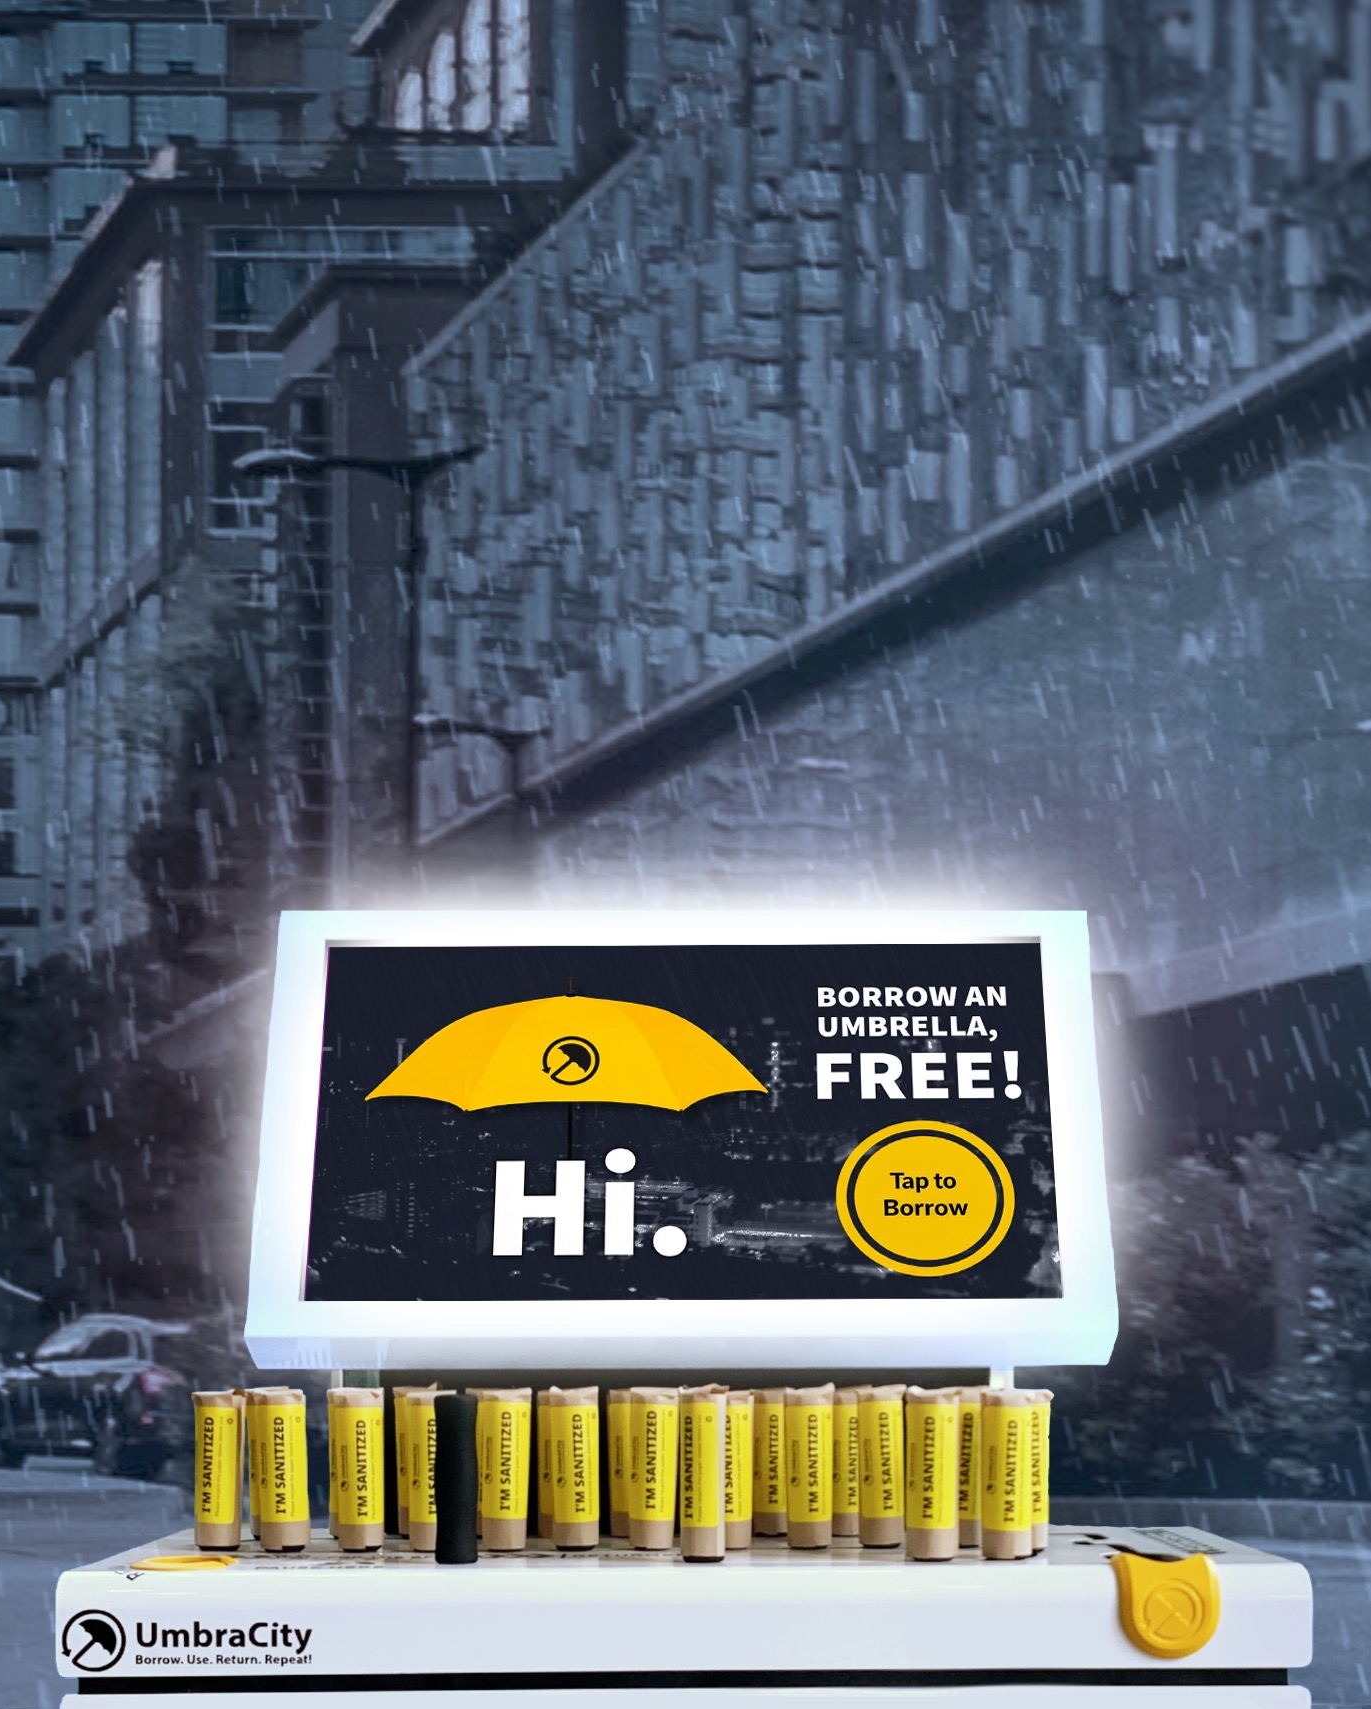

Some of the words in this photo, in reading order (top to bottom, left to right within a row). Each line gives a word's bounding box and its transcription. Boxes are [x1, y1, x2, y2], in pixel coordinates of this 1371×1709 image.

[817, 986, 957, 1007] BORROW
[964, 986, 1007, 1006] AN
[817, 1015, 998, 1042] UMBRELLA,
[816, 1051, 1022, 1100] FREE!
[492, 1148, 688, 1257] Hi.
[883, 1199, 968, 1216] Borrow
[889, 1172, 929, 1193] Tap
[934, 1173, 957, 1189] to
[203, 1417, 214, 1487] SANITIZED
[274, 1416, 286, 1488] SANITIZED
[356, 1420, 368, 1491] SANITIZED
[500, 1411, 512, 1485] SANITIZED
[572, 1413, 585, 1491] SANITIZED
[646, 1410, 657, 1484] SANITIZED
[684, 1416, 693, 1492] SANITIZED
[769, 1414, 779, 1480] SANITIZED
[808, 1414, 819, 1487] SANITIZED
[879, 1412, 892, 1488] SANITIZED
[923, 1416, 936, 1492] SANITIZED
[1005, 1420, 1018, 1495] SANITIZED
[135, 1654, 184, 1665] Borrow.
[186, 1654, 213, 1665] Use.
[216, 1654, 262, 1665] Return.
[264, 1654, 312, 1667] Repeat!
[136, 1621, 313, 1655] UmbraCity
